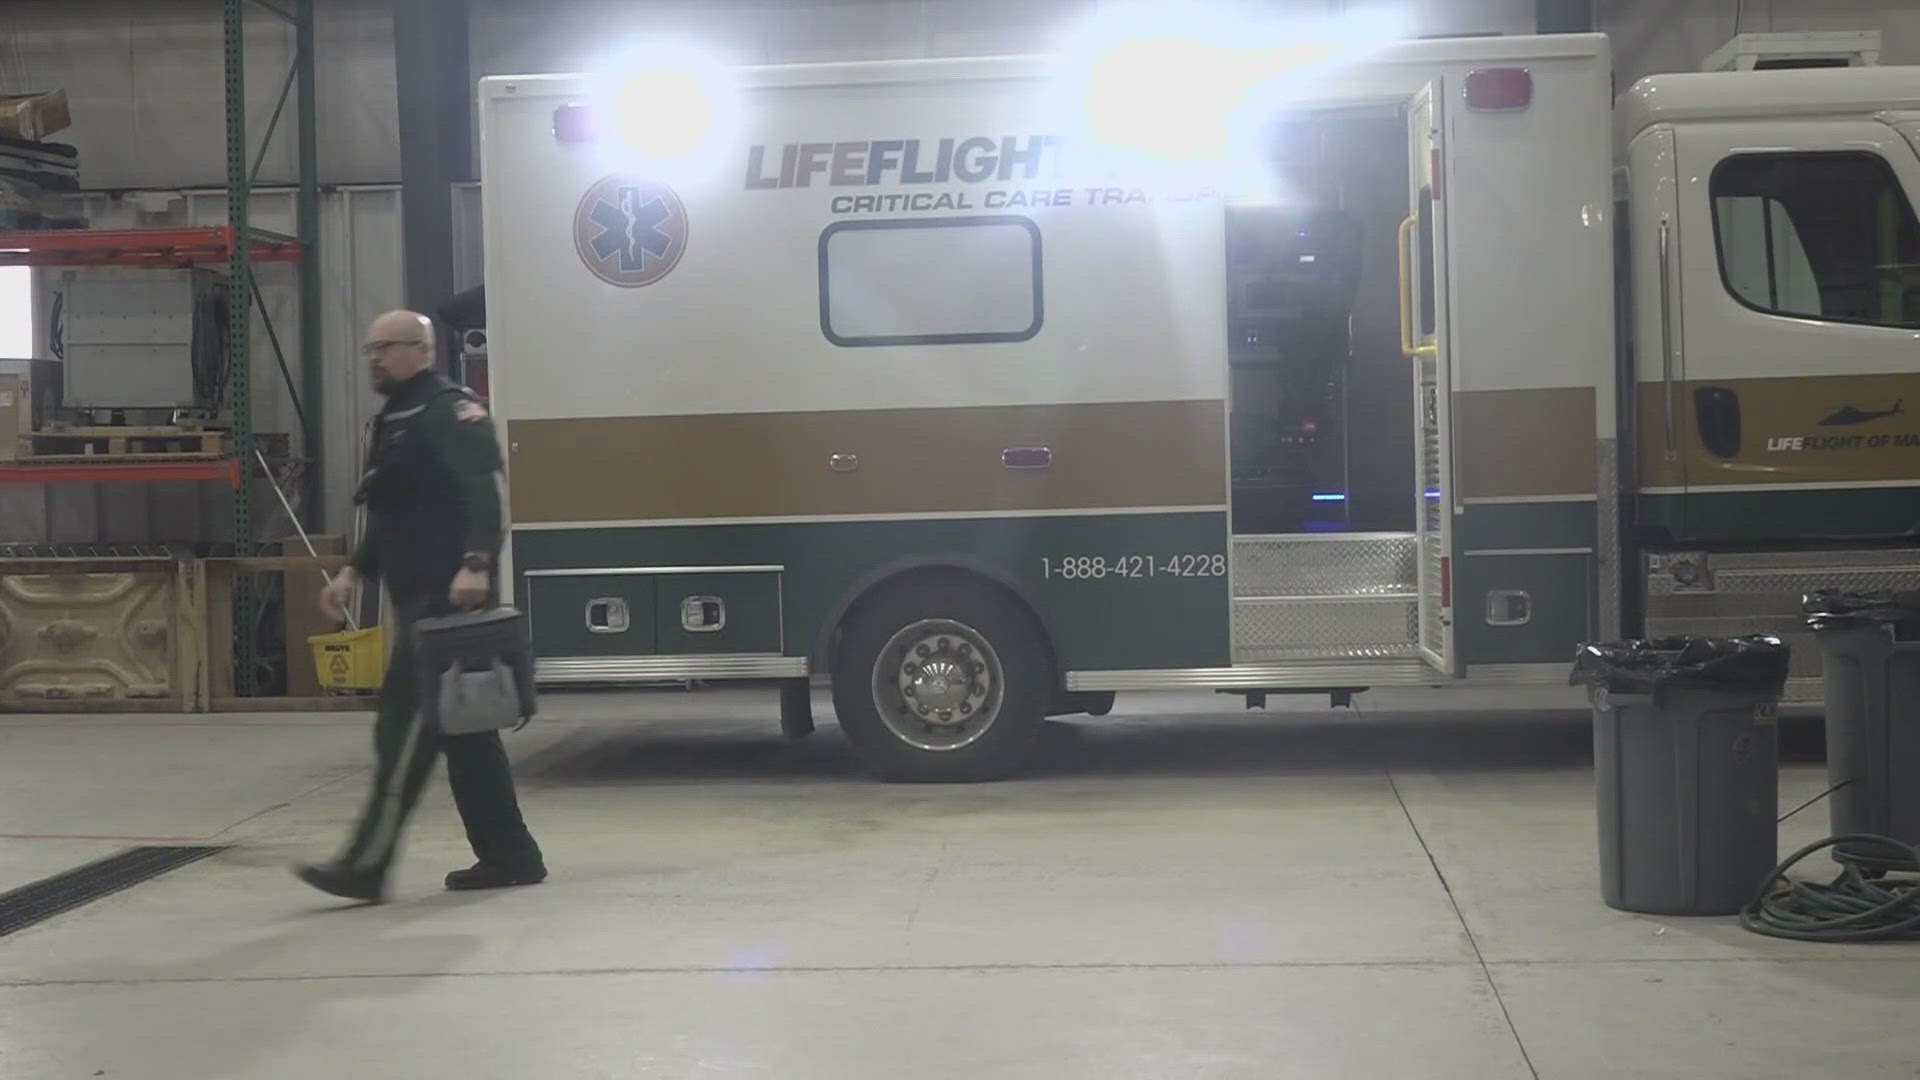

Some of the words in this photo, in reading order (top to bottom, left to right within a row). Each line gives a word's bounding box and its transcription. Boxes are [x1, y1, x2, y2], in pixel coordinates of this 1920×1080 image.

[831, 191, 973, 214] CRITICAL
[983, 188, 1073, 209] CARE
[1767, 436, 1865, 451] LIFEFLIGHT
[1867, 434, 1890, 448] OF
[1041, 553, 1226, 580] 1-888-421-4228
